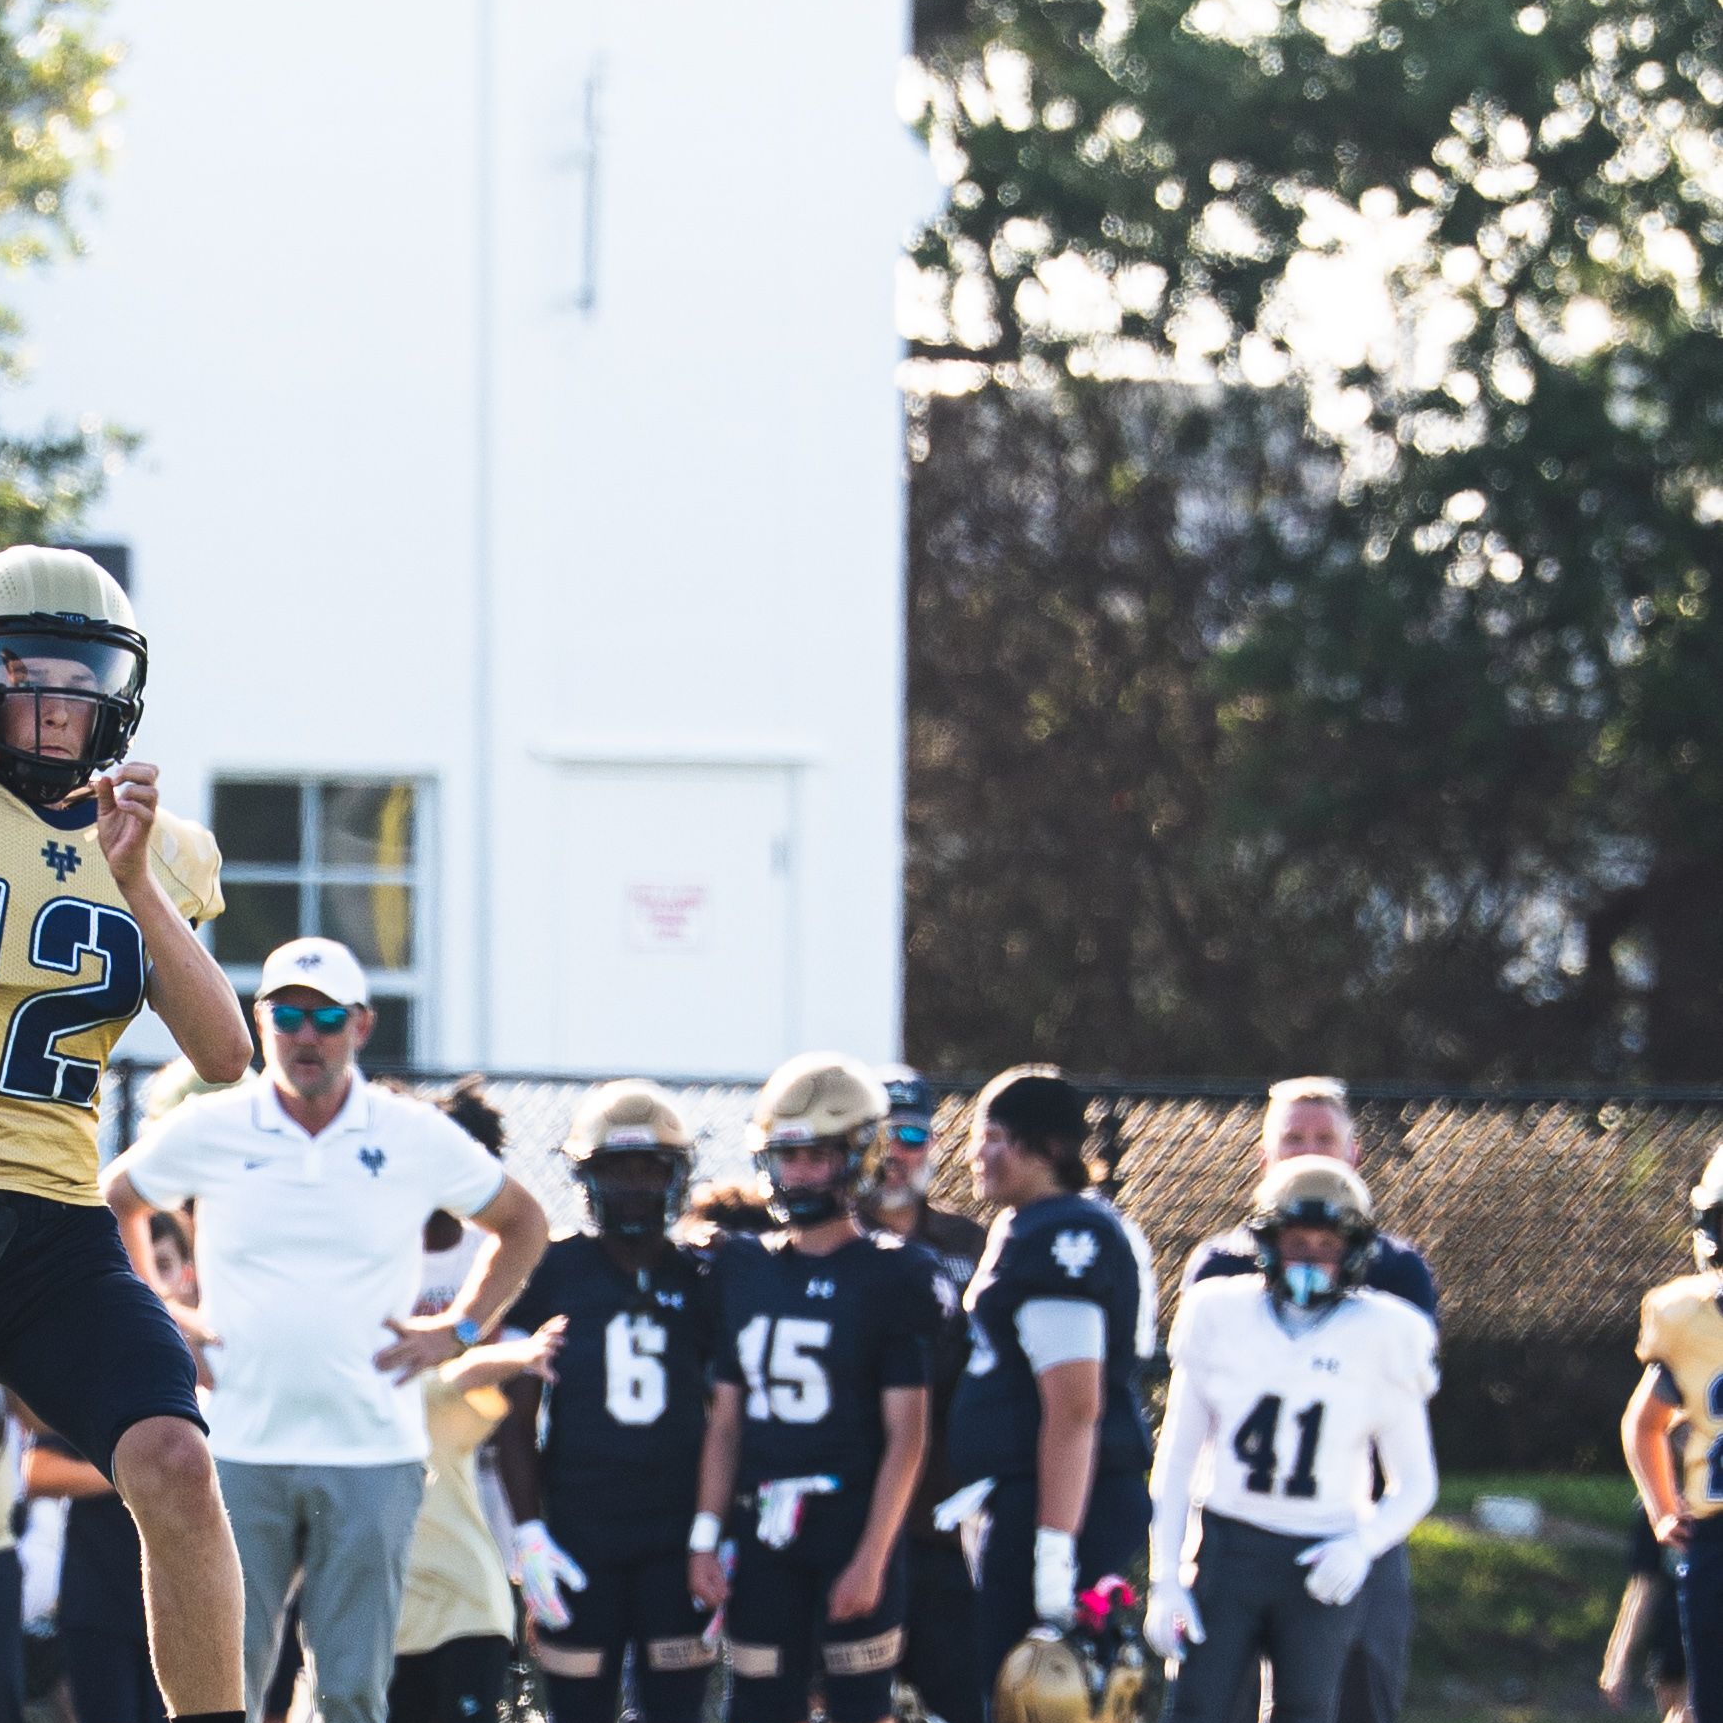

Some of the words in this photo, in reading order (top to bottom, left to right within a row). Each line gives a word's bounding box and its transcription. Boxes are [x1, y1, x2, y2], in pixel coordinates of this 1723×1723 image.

[604, 1309, 668, 1425] 6
[736, 1312, 833, 1424] 15
[1235, 1391, 1324, 1498] 41
